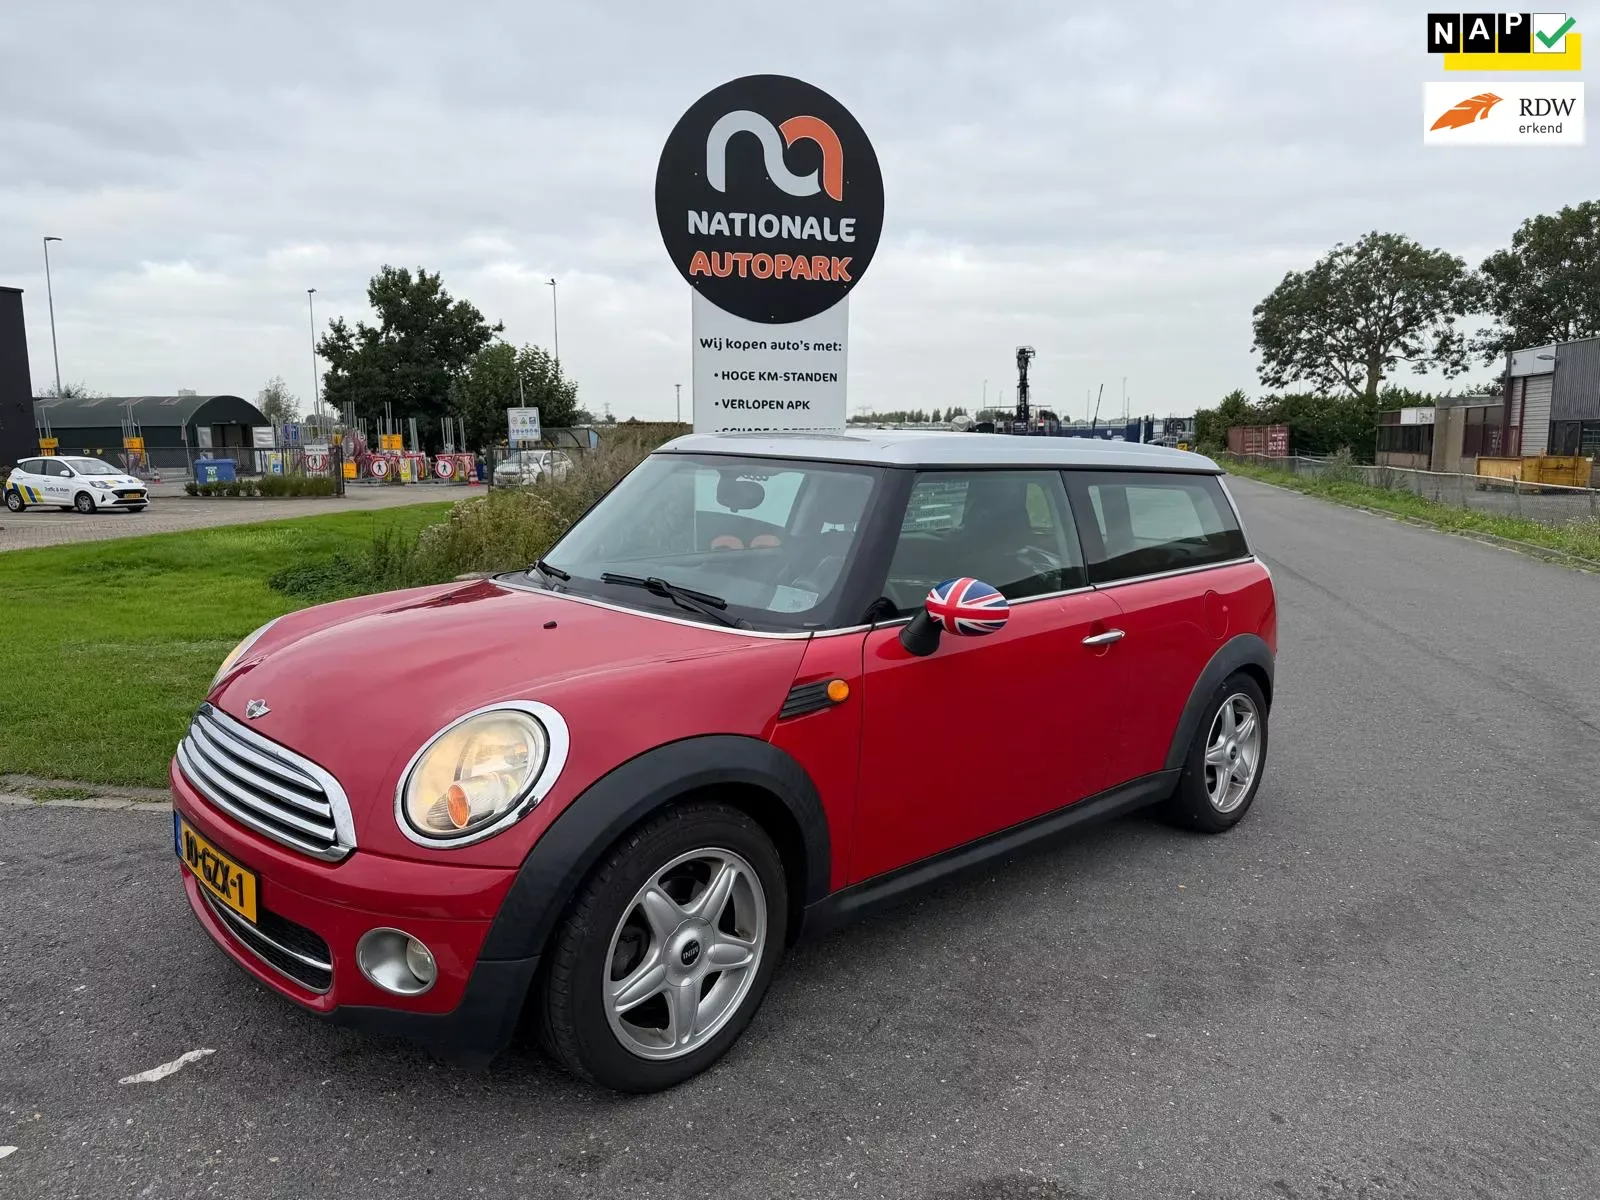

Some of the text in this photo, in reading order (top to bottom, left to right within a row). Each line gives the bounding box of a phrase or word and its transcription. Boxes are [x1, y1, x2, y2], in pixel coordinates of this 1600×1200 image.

[687, 209, 857, 243] NATIONALE
[689, 251, 853, 282] AUTOPARK
[700, 338, 842, 352] Wij kopen auto's met:
[721, 370, 838, 382] HOGE KM-STANDEN
[721, 398, 811, 410] VERLOPEN APK
[185, 830, 244, 908] 10-GZX-1
